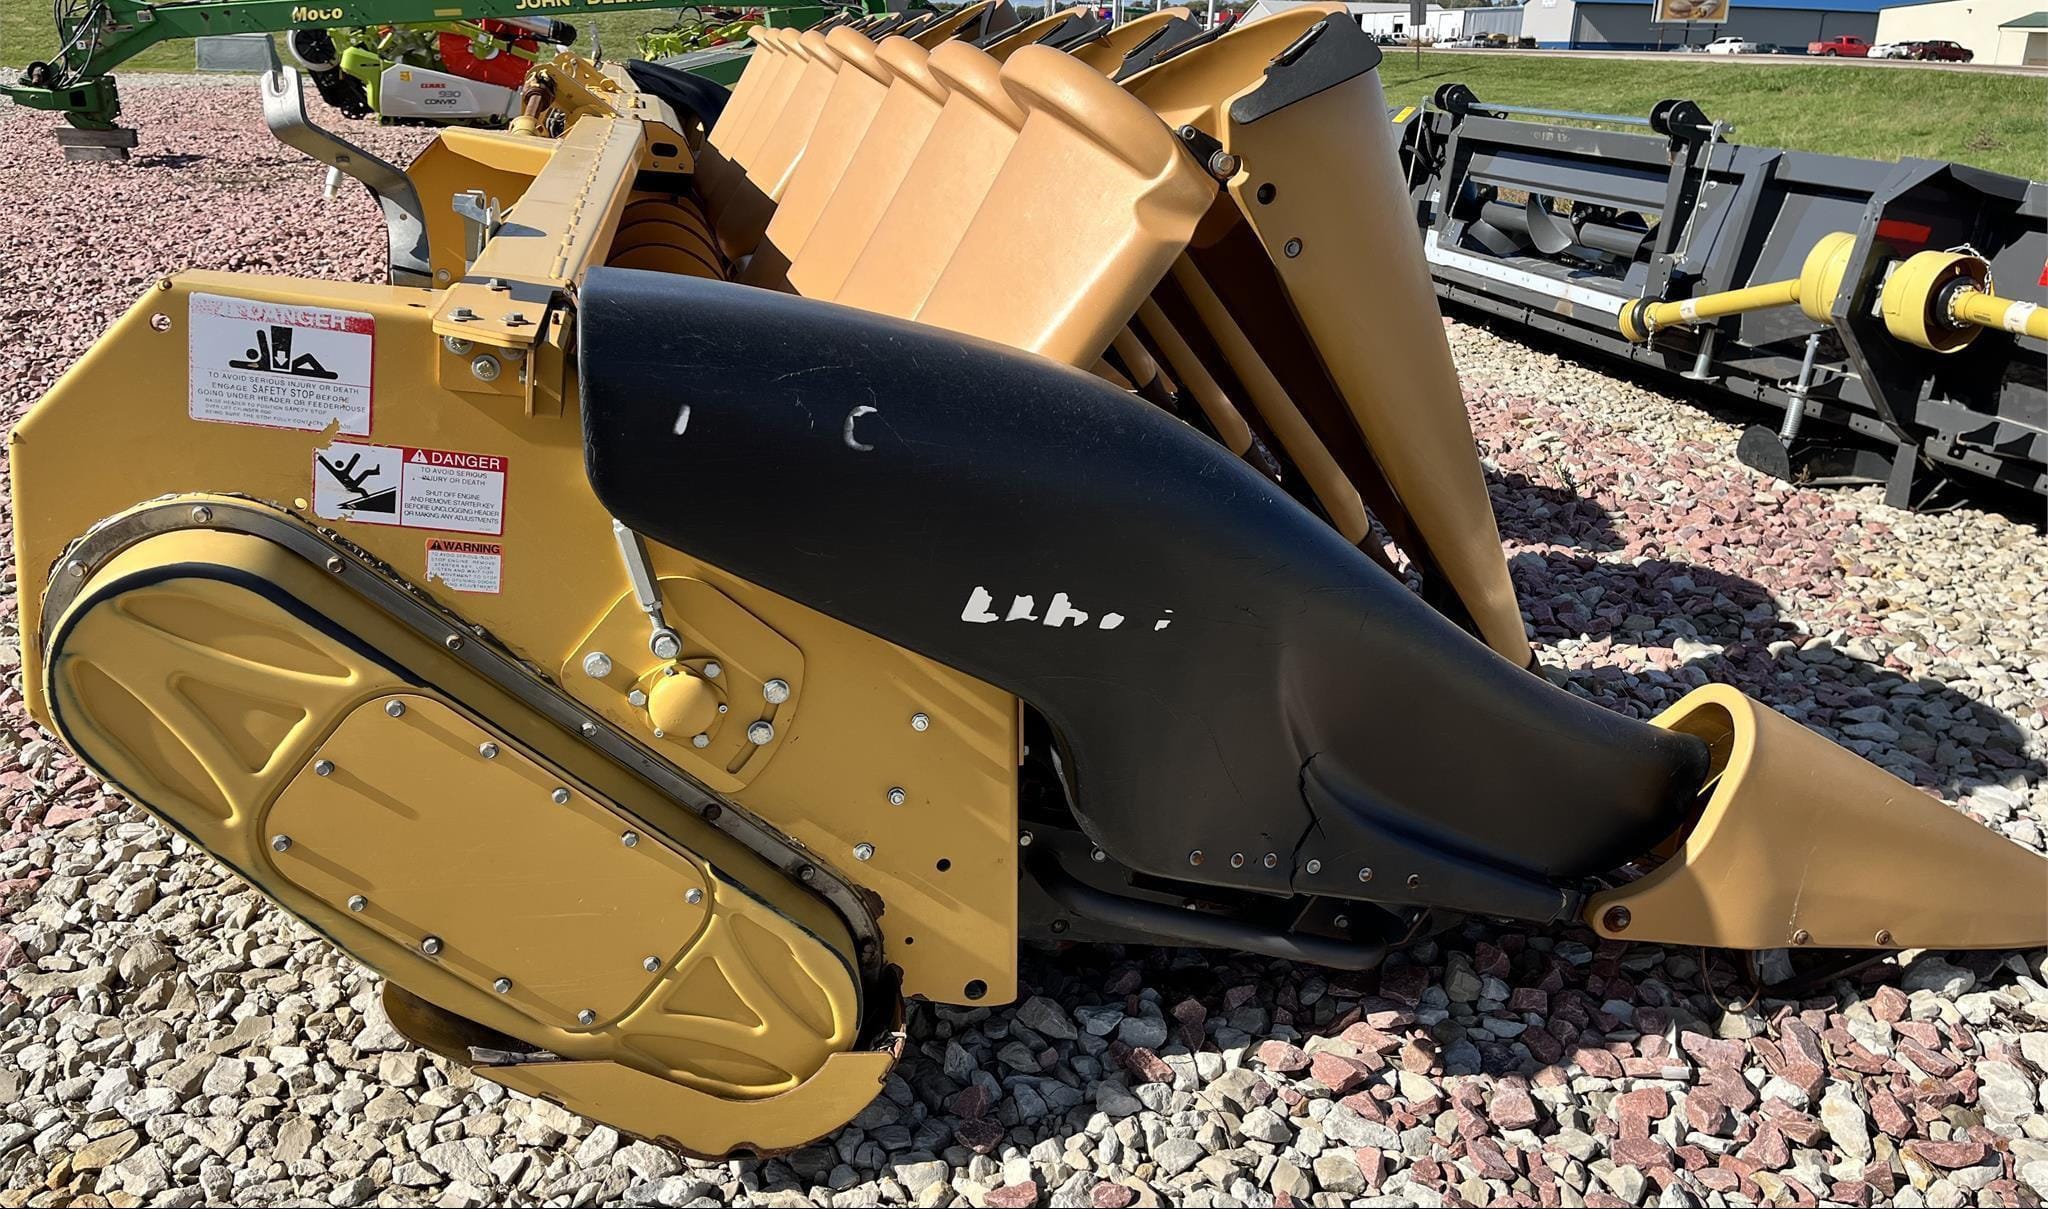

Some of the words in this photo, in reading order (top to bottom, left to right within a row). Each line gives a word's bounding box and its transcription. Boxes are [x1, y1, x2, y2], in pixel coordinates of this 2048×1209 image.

[209, 371, 219, 379] TO
[222, 373, 247, 381] AVOID
[250, 376, 286, 386] SERIOUS
[288, 381, 317, 389] INJURY
[333, 386, 359, 394] DEATH
[212, 382, 247, 392] ENGAGE
[252, 384, 287, 396] SAFETY
[291, 389, 315, 399] STOP
[316, 394, 349, 404] BEFORE
[198, 388, 224, 397] GOING
[227, 392, 255, 400] UNDER
[258, 395, 291, 404] HEADER
[308, 401, 366, 413] FEEDERHOUSE
[432, 452, 500, 470] DANGER
[457, 471, 487, 479] SERIOUS
[425, 497, 452, 505] REMOVE
[453, 500, 481, 508] STARTER
[415, 511, 440, 519] MAKING
[455, 514, 499, 524] ADJUSTMENTS
[431, 505, 473, 514] UNCLOGGING
[474, 509, 499, 517] HEADER
[443, 541, 500, 554] WARNING
